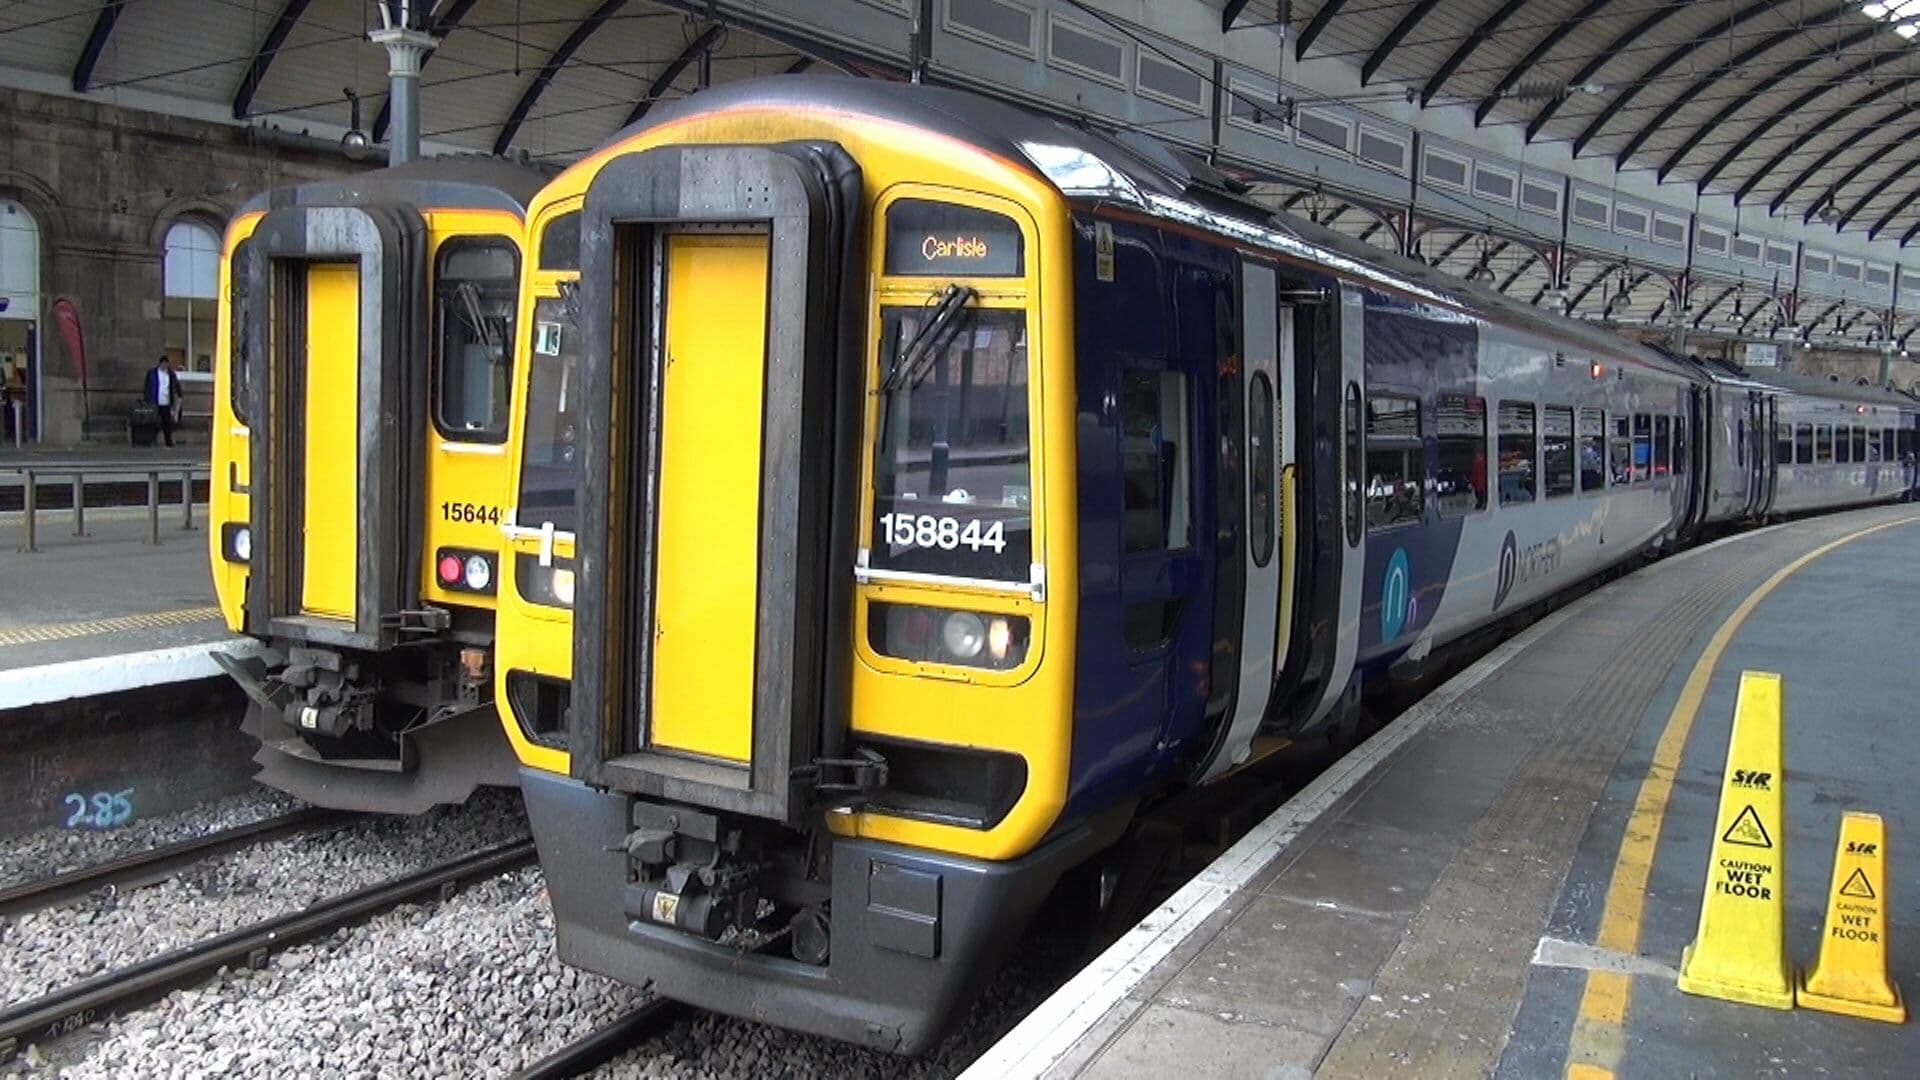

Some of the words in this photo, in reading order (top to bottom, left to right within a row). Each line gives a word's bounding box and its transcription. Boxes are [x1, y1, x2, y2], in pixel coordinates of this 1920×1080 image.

[922, 236, 987, 260] Carlisle
[441, 501, 503, 526] 15644
[880, 512, 1007, 554] 158844
[65, 786, 136, 828] 2.85
[1720, 859, 1772, 874] CAUTION
[1726, 869, 1763, 885] WET
[1716, 881, 1771, 900] FLOOR
[1837, 903, 1877, 915] CAUTION
[1841, 914, 1871, 927] WET
[1832, 926, 1879, 943] FLOOR
